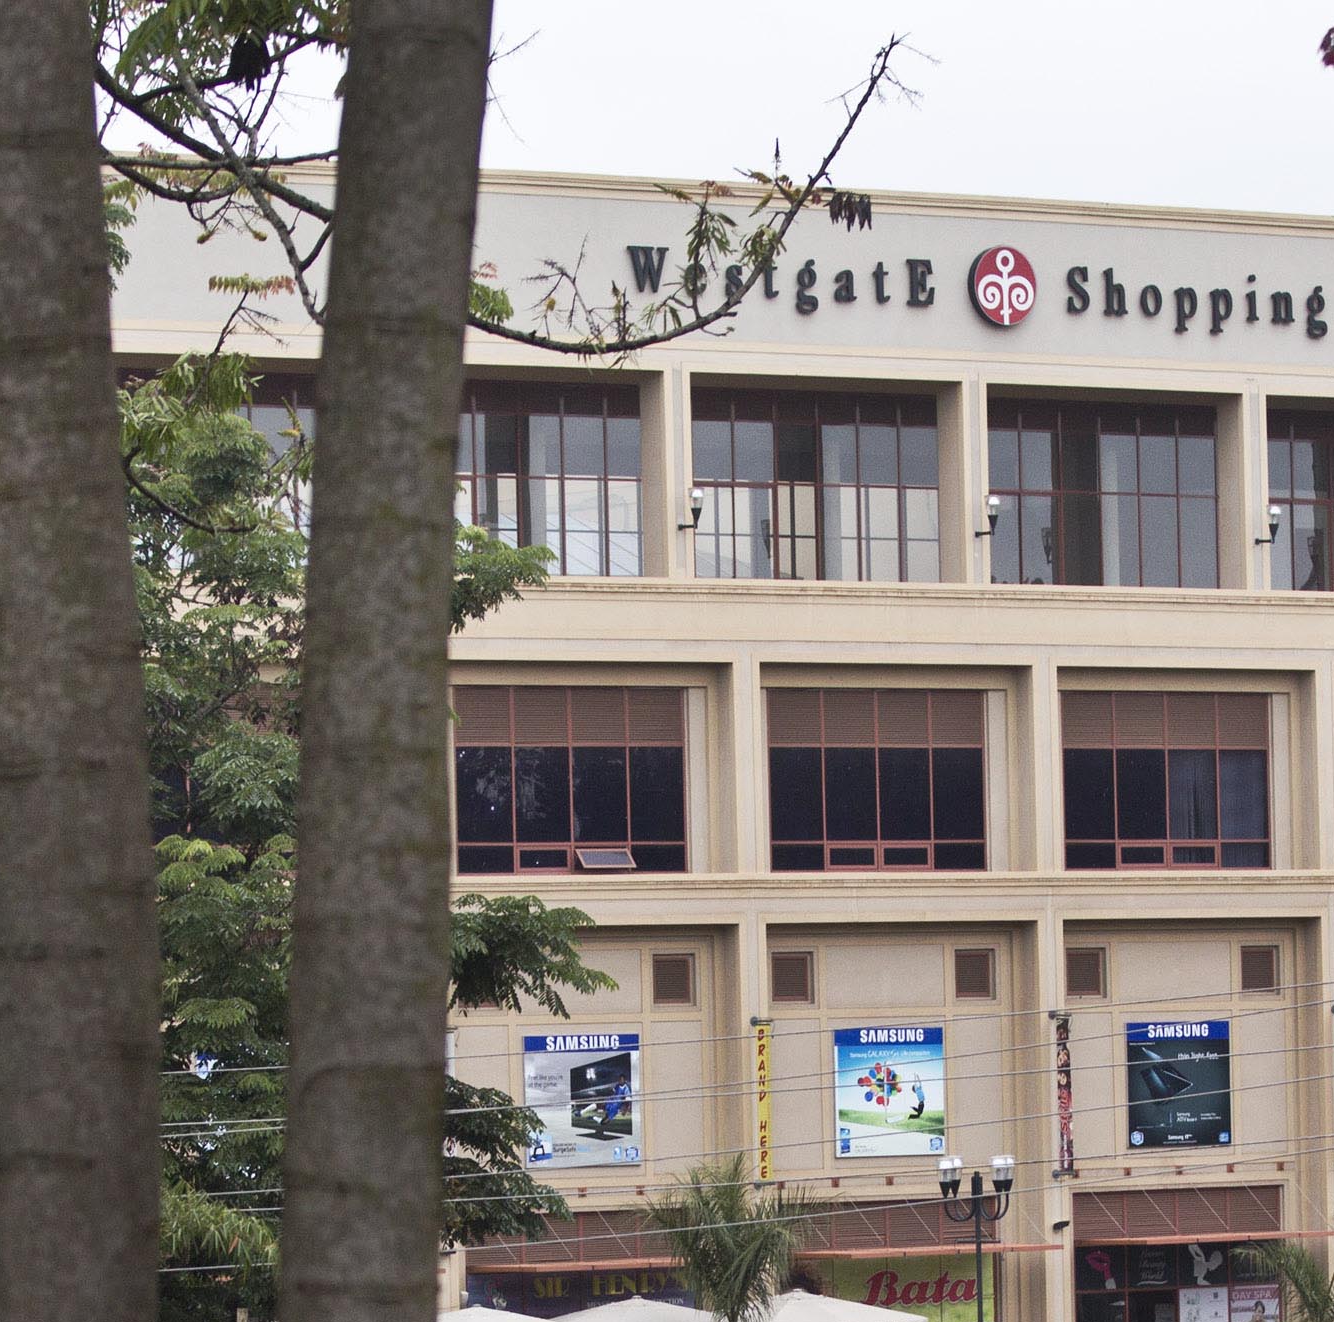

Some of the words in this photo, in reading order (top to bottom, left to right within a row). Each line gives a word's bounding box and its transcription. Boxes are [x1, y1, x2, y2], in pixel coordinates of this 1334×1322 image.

[1066, 266, 1328, 339] Shopping
[546, 1035, 619, 1051] SAMSUNG
[859, 1028, 924, 1043] SAMSUNG
[1147, 1024, 1209, 1038] SAMSUNG
[757, 1028, 767, 1102] BRAND
[759, 1120, 768, 1178] HERE
[860, 1269, 980, 1307] Bata
[1232, 1291, 1253, 1300] DAY
[1255, 1290, 1272, 1299] SPA
